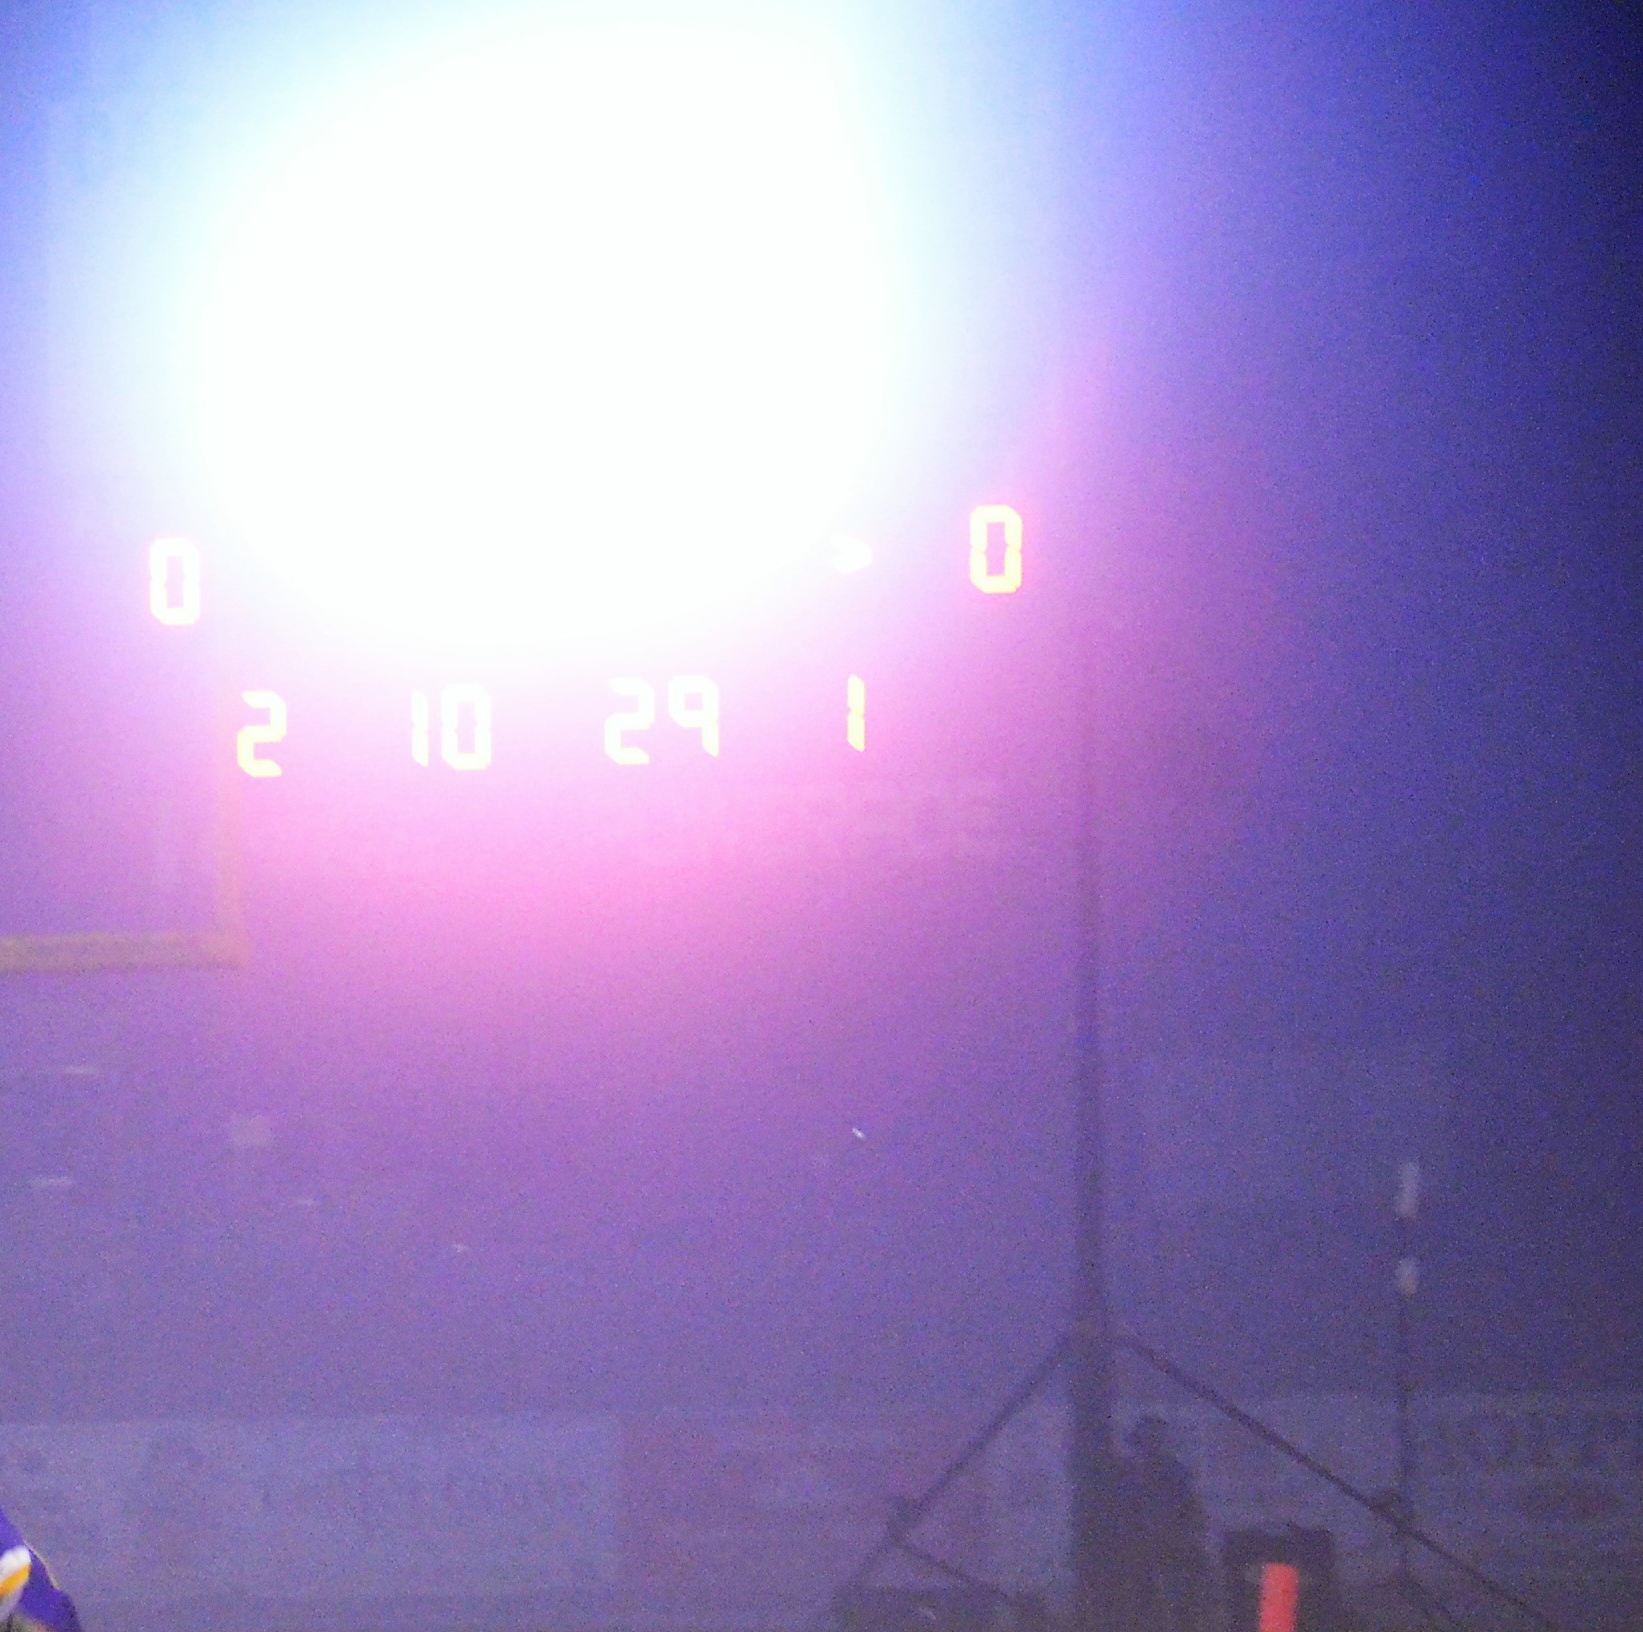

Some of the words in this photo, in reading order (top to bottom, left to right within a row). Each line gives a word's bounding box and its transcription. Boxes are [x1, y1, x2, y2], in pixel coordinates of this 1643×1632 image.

[150, 538, 201, 625] 0
[969, 505, 1022, 593] 0
[236, 690, 287, 777] 2
[411, 683, 491, 769] 10
[604, 675, 718, 765] 29
[847, 675, 865, 751] 1
